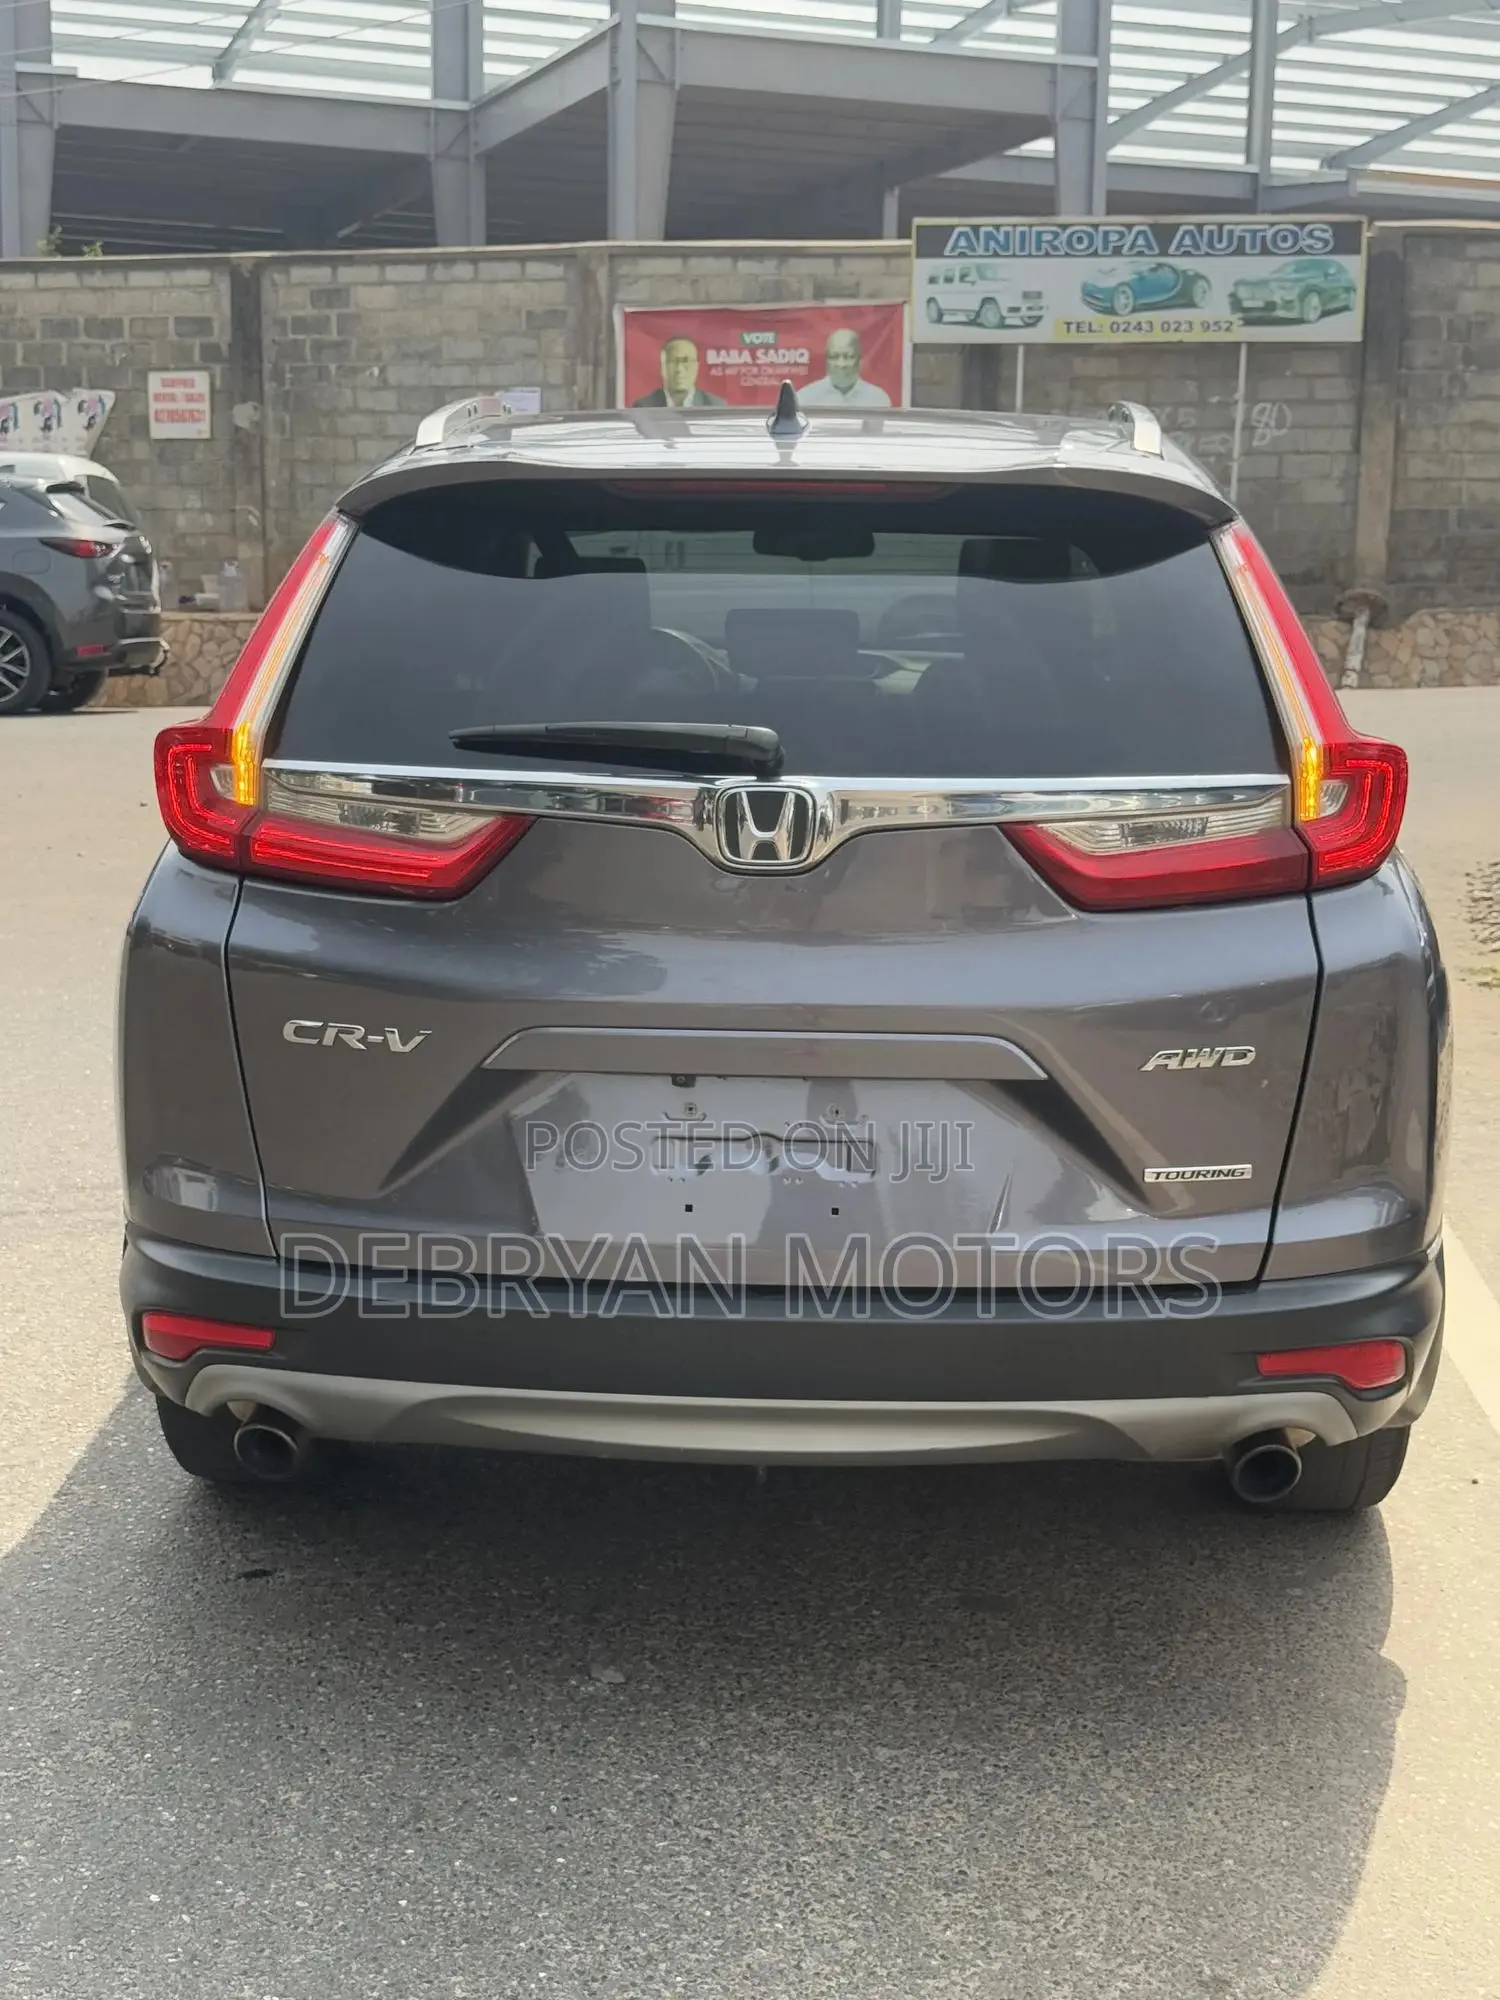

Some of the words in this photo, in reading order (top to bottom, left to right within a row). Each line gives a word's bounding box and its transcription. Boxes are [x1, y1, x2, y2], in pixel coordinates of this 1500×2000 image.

[944, 225, 1160, 256] ANIROPA
[1168, 224, 1335, 254] AUTOS
[1063, 321, 1102, 334] TEL:
[1109, 320, 1154, 334] 0243
[1160, 320, 1193, 333] 023
[1200, 320, 1234, 333] 952
[742, 331, 776, 344] VOTE
[706, 348, 753, 365] BABA
[282, 1019, 433, 1053] CR-V
[1140, 1046, 1256, 1071] AWD
[1151, 1166, 1247, 1182] TOURING
